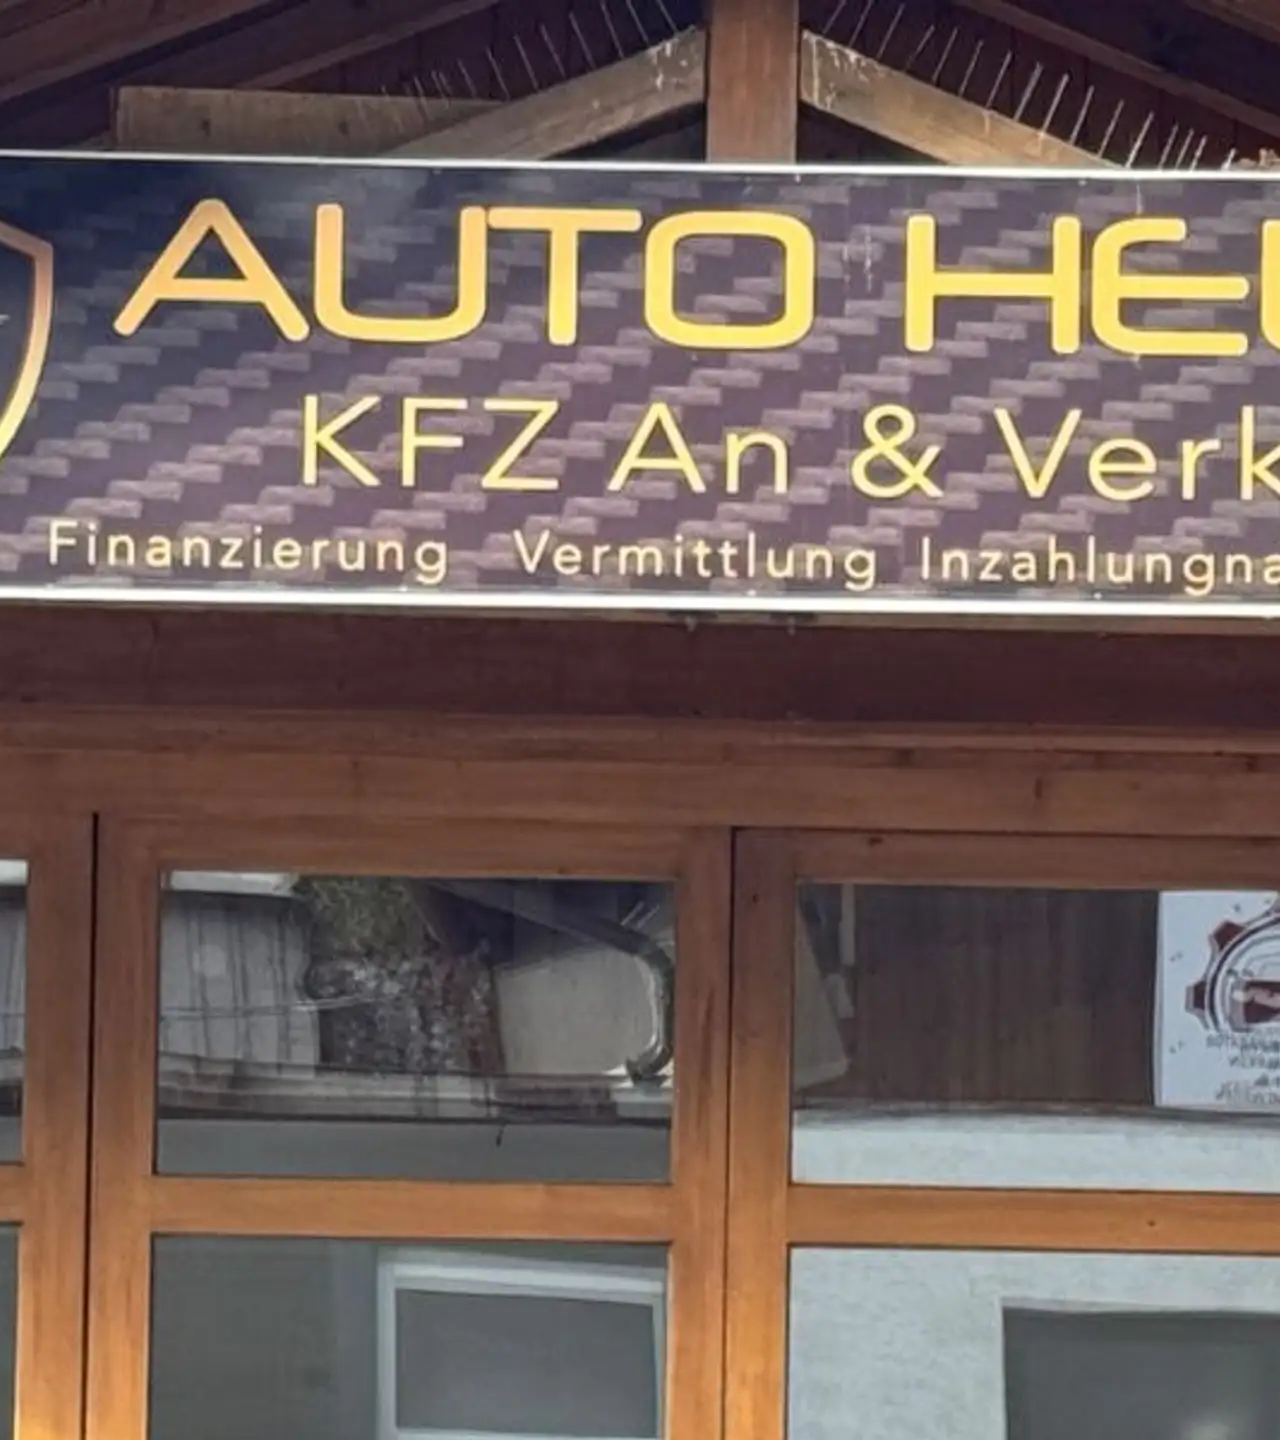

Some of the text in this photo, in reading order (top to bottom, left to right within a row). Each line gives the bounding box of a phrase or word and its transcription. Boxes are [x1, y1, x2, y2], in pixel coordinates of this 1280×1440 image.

[113, 198, 815, 350] AUTO
[301, 394, 560, 491] KFZ
[607, 402, 789, 494] An
[850, 403, 944, 500] &
[48, 519, 448, 586] Finanzierung
[512, 529, 877, 591] Vermittlung
